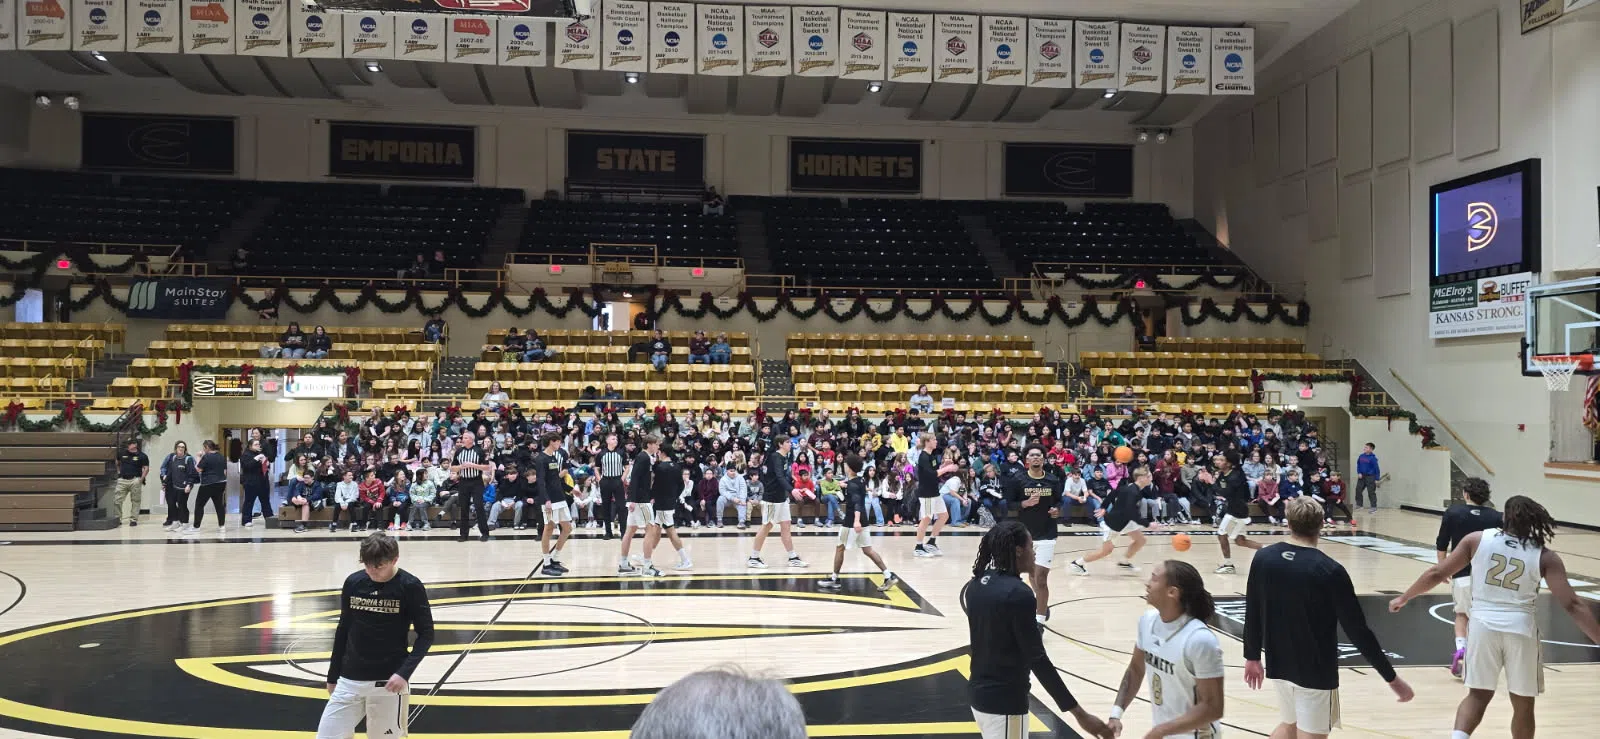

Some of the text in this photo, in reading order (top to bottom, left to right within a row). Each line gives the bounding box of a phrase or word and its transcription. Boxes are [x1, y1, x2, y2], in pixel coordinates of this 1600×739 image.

[342, 139, 463, 165] EMPORIA
[596, 148, 676, 172] STATE
[798, 154, 913, 178] HORNETS
[165, 287, 226, 298] MainStay
[1433, 286, 1472, 298] McElroy's
[1436, 306, 1523, 324] KANSAS STRONG.
[1485, 553, 1525, 591] 22
